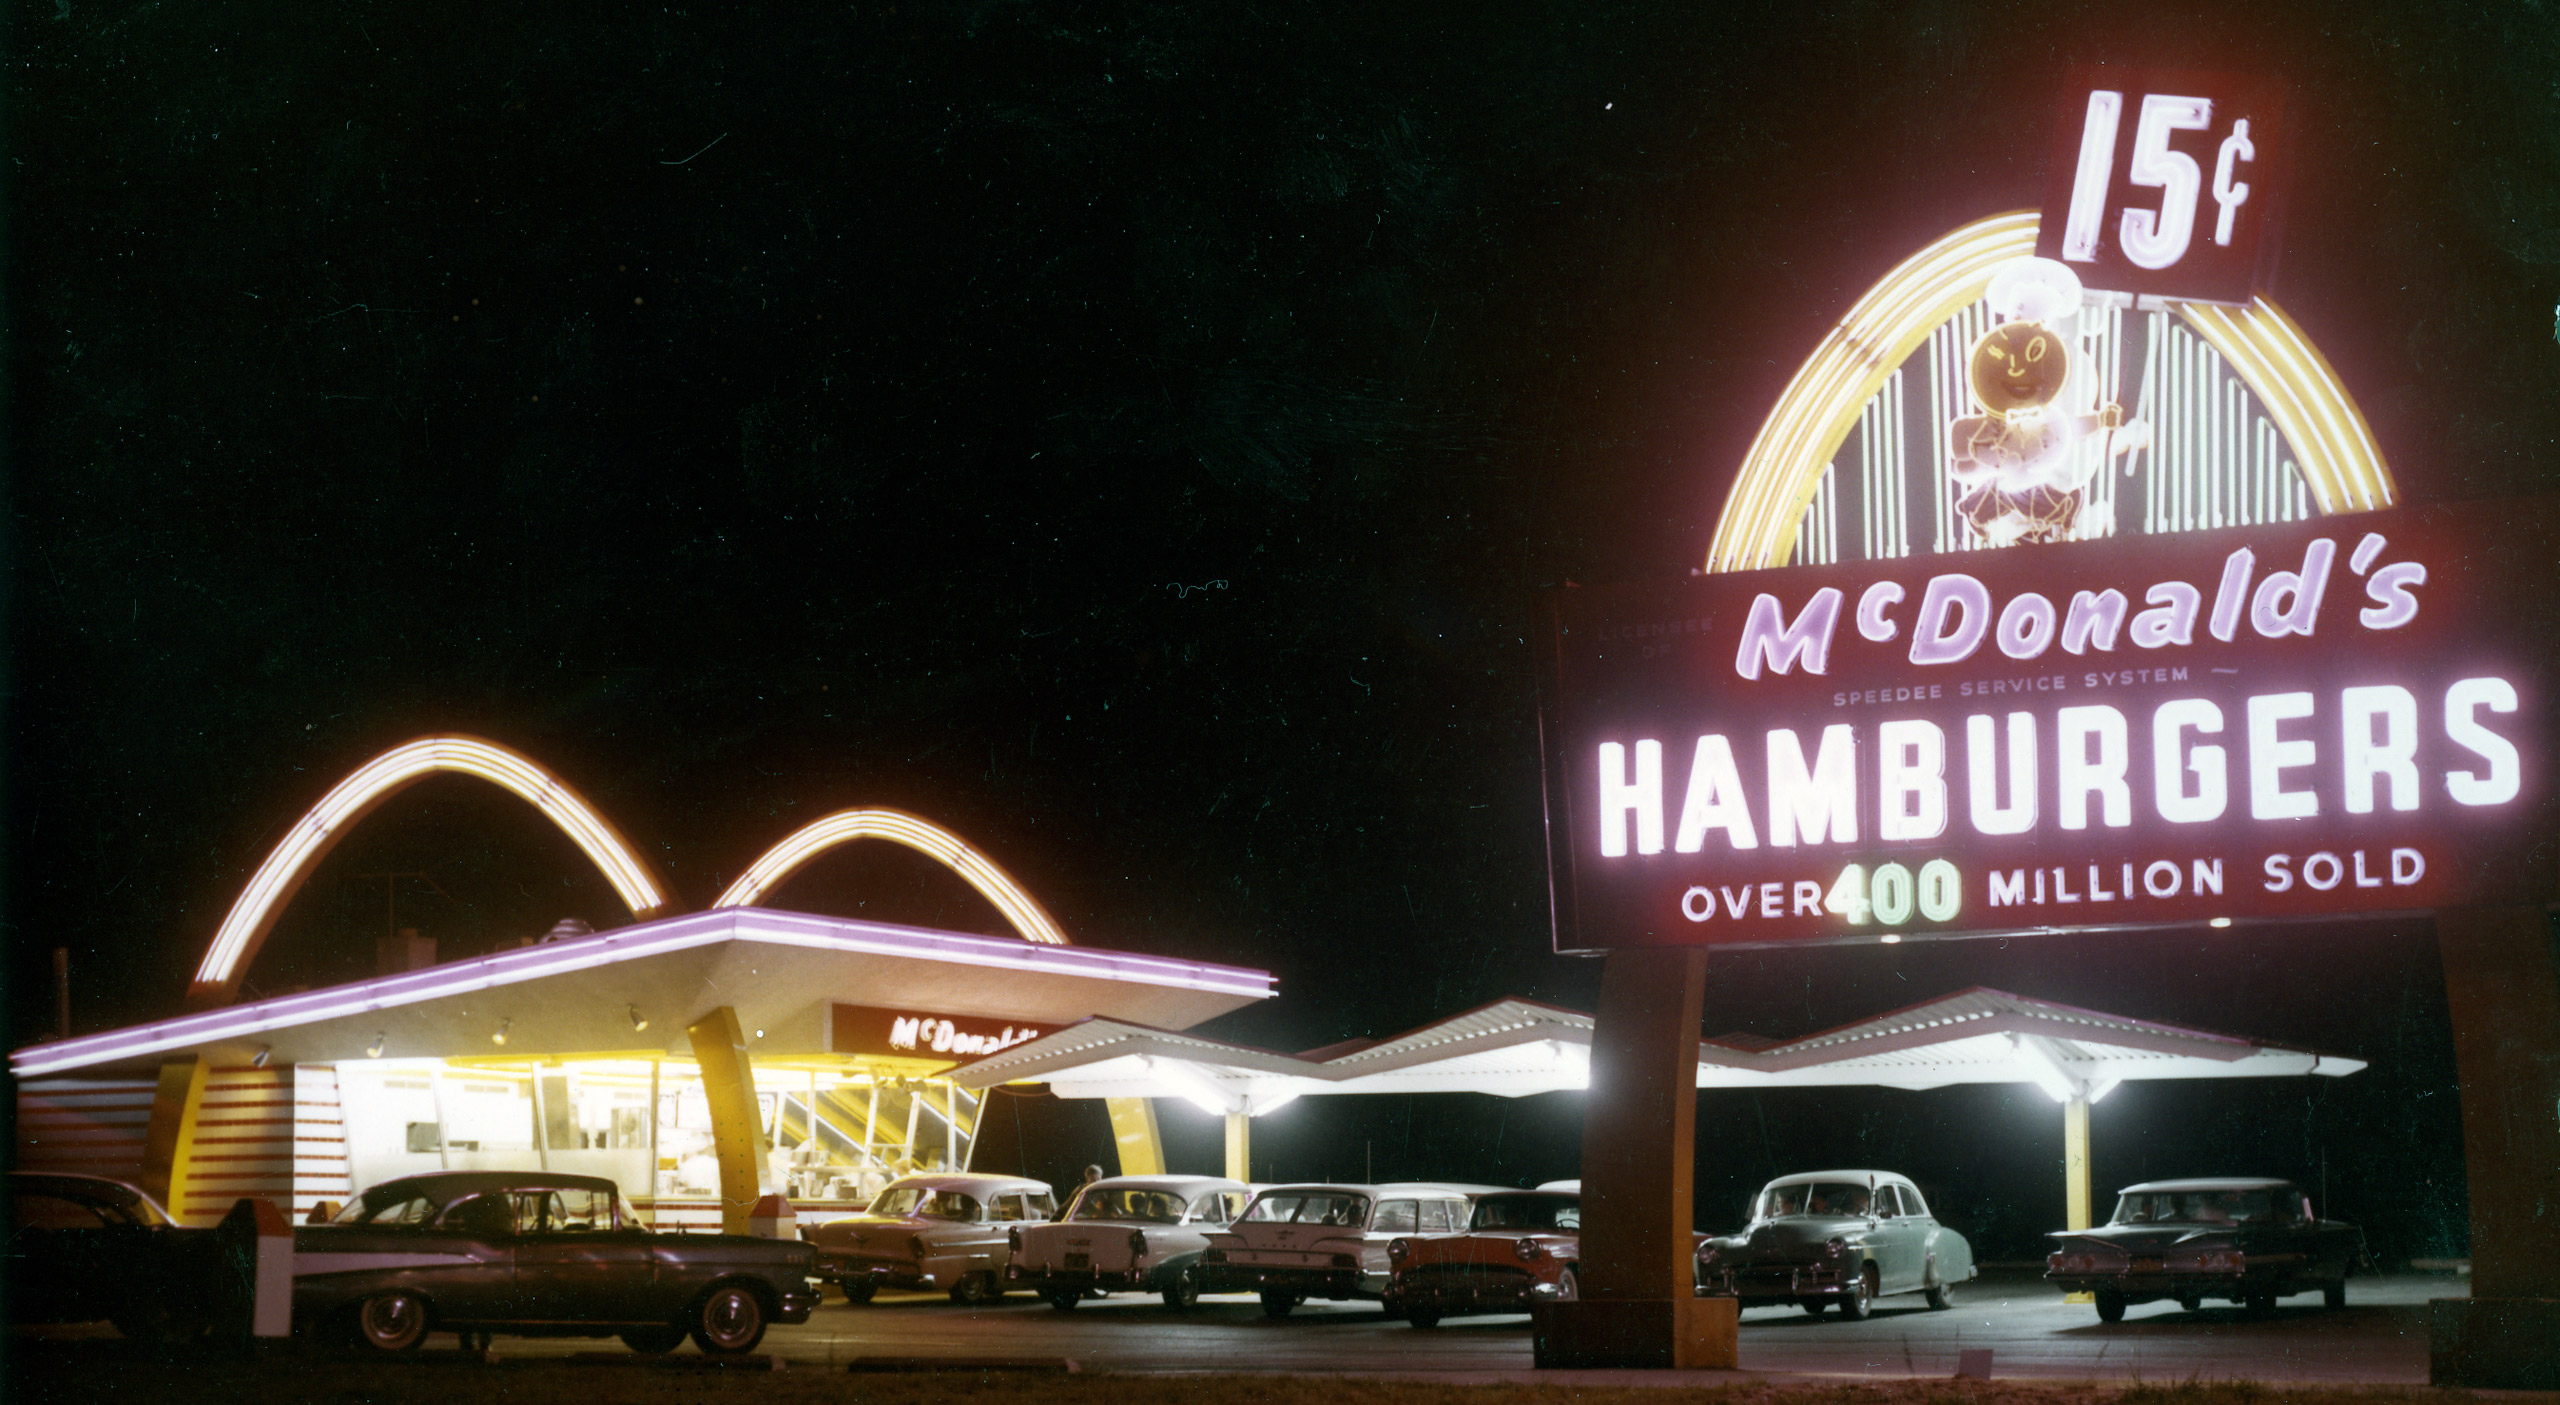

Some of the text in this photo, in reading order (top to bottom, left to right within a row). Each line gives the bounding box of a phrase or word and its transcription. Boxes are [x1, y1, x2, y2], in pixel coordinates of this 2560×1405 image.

[2062, 90, 2255, 270] 15¢
[1735, 533, 2427, 681] McDonald's
[1833, 666, 2189, 707] SPEEDEE SERVICE SYSTEM
[1598, 676, 2521, 858] HAMBURGERS
[1682, 848, 2427, 926] OVER 400 MILLION SOLD
